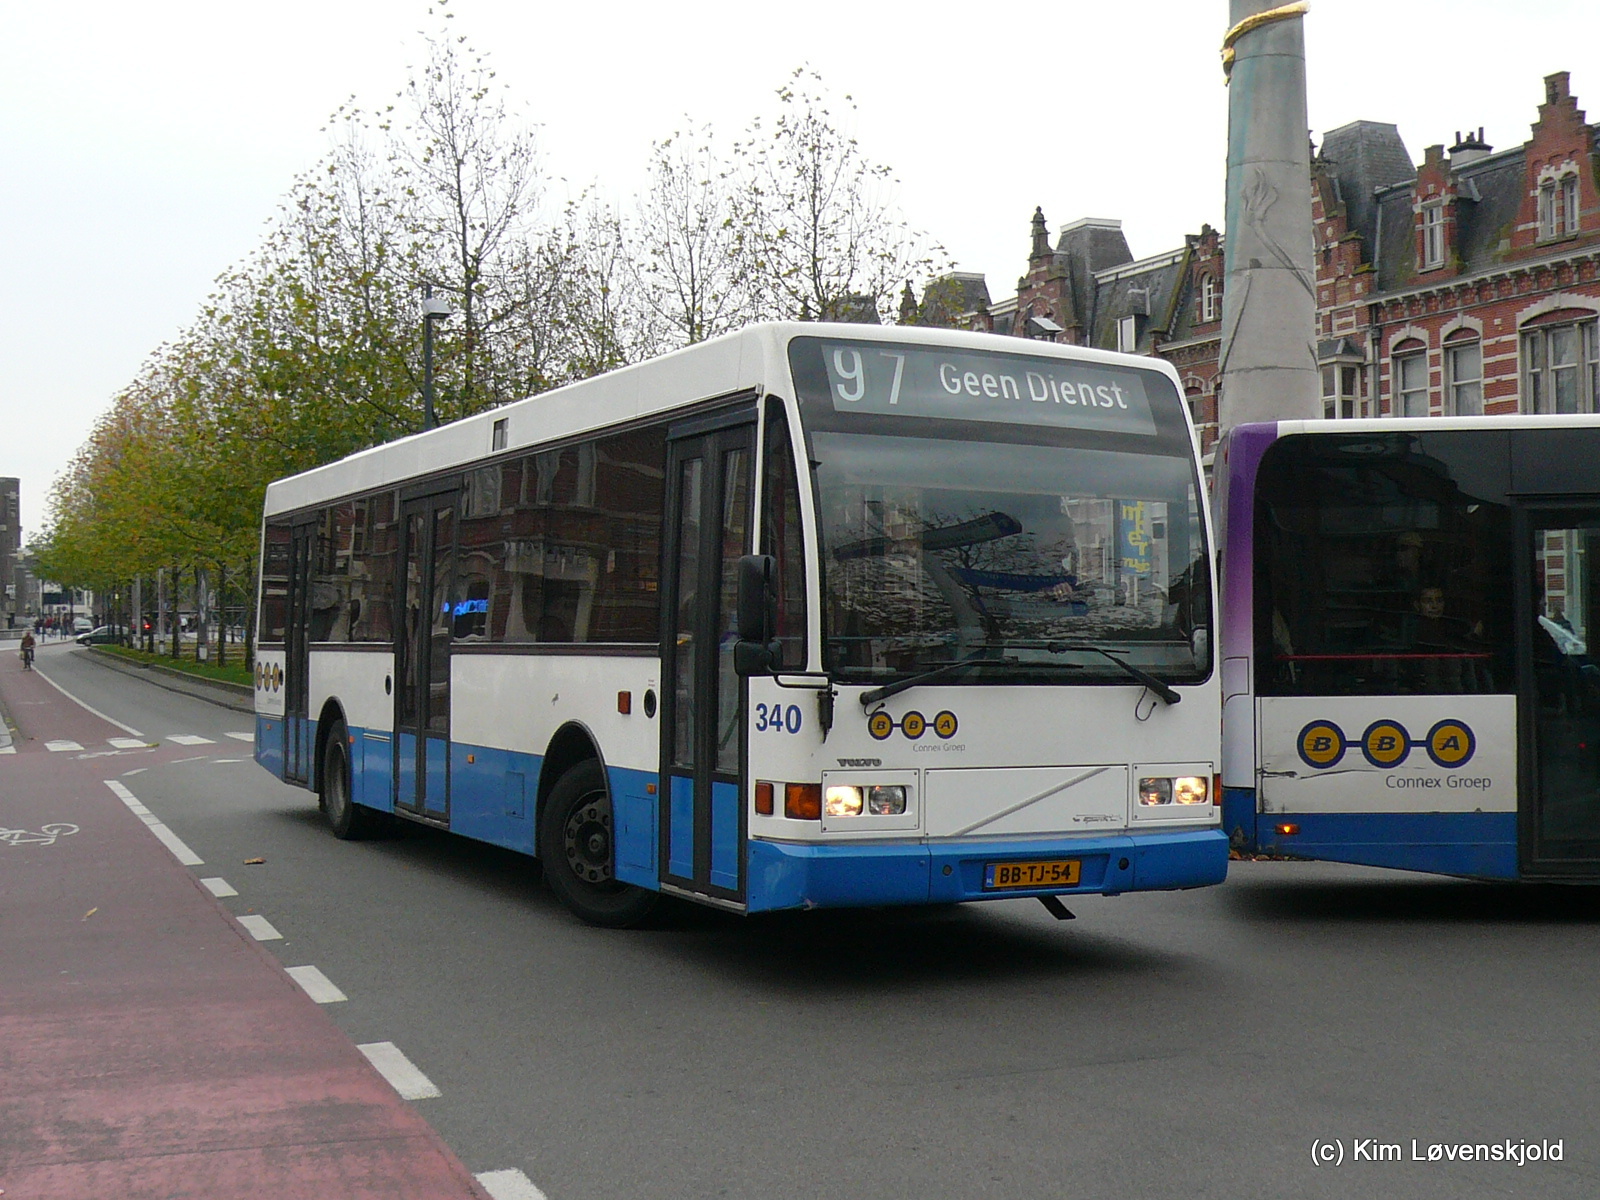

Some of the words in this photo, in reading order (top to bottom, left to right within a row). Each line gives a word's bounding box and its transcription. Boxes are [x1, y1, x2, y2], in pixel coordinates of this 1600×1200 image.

[939, 362, 1020, 400] Geen
[1025, 371, 1128, 409] Dienst
[755, 703, 802, 734] 340
[943, 743, 966, 753] Groep
[1385, 775, 1441, 789] Connex
[1446, 775, 1491, 791] Groep
[1000, 864, 1071, 884] BB-TJ-54
